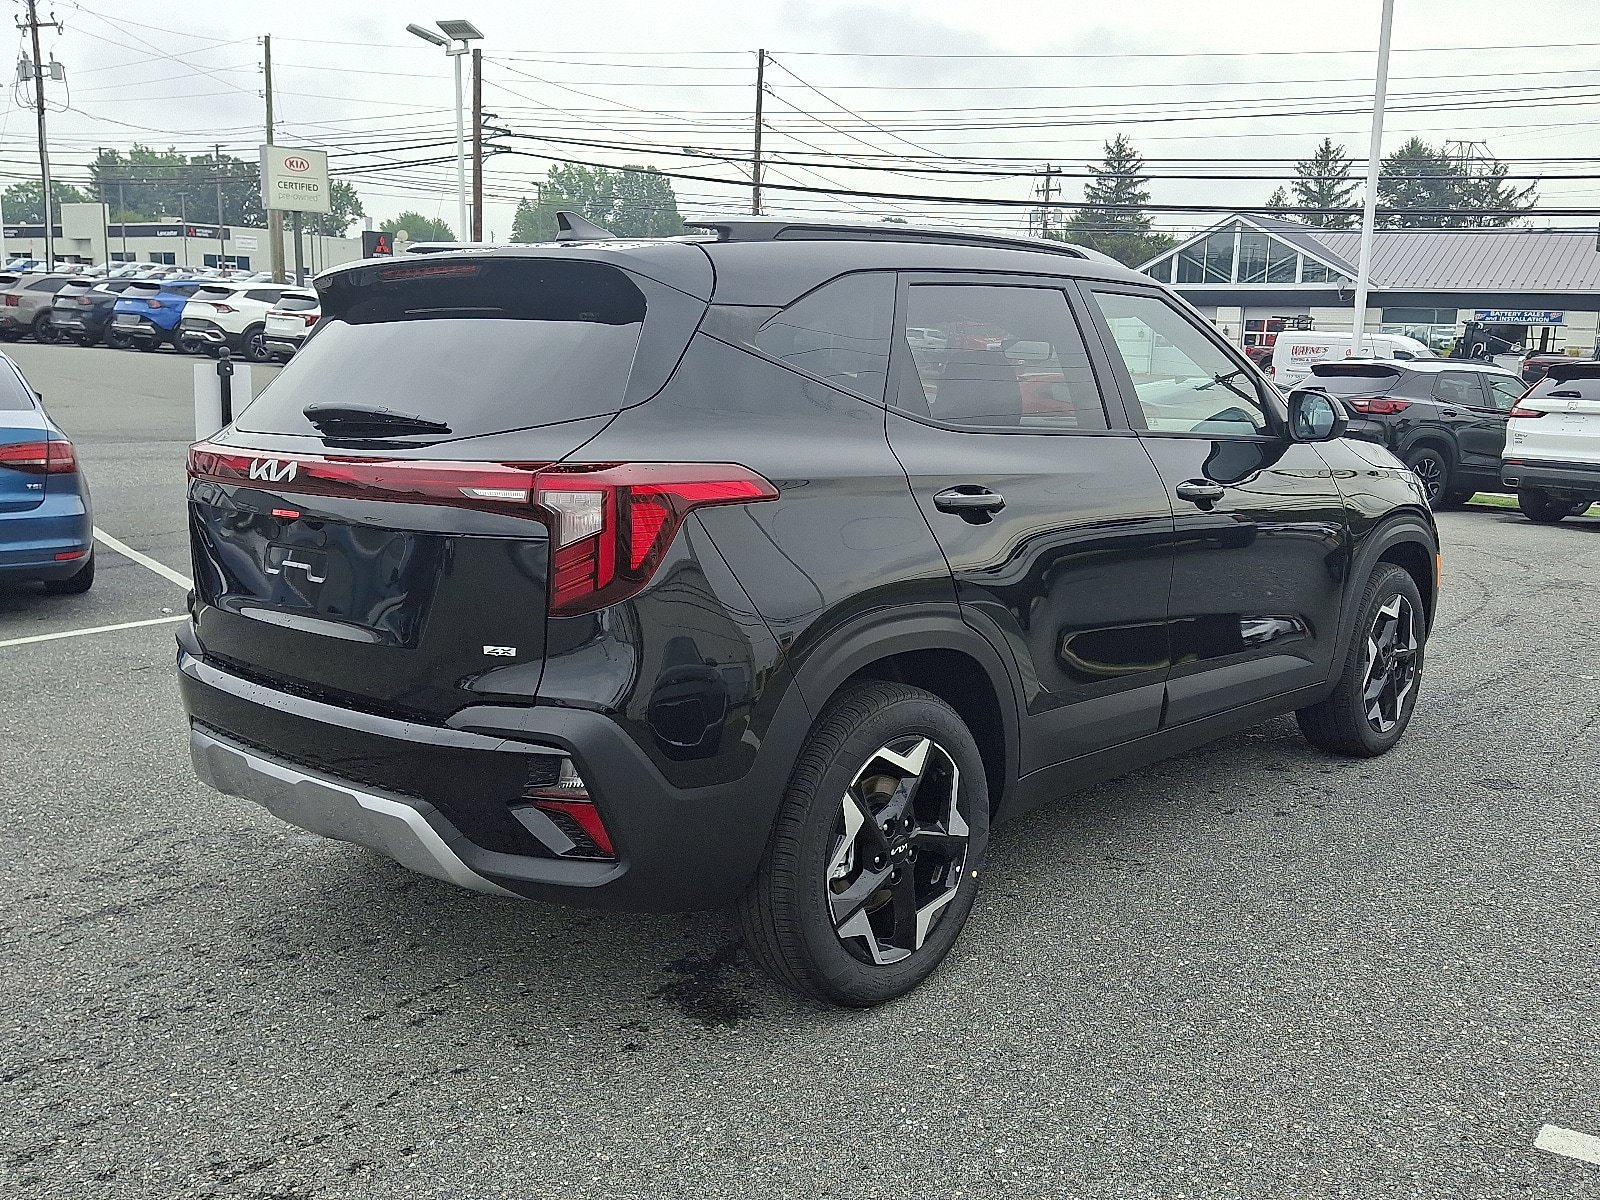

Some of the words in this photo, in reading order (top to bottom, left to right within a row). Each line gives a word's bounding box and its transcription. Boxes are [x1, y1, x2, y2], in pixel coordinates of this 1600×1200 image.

[288, 160, 306, 169] KIA
[277, 181, 319, 192] CERTIFIED
[249, 457, 298, 483] KIA
